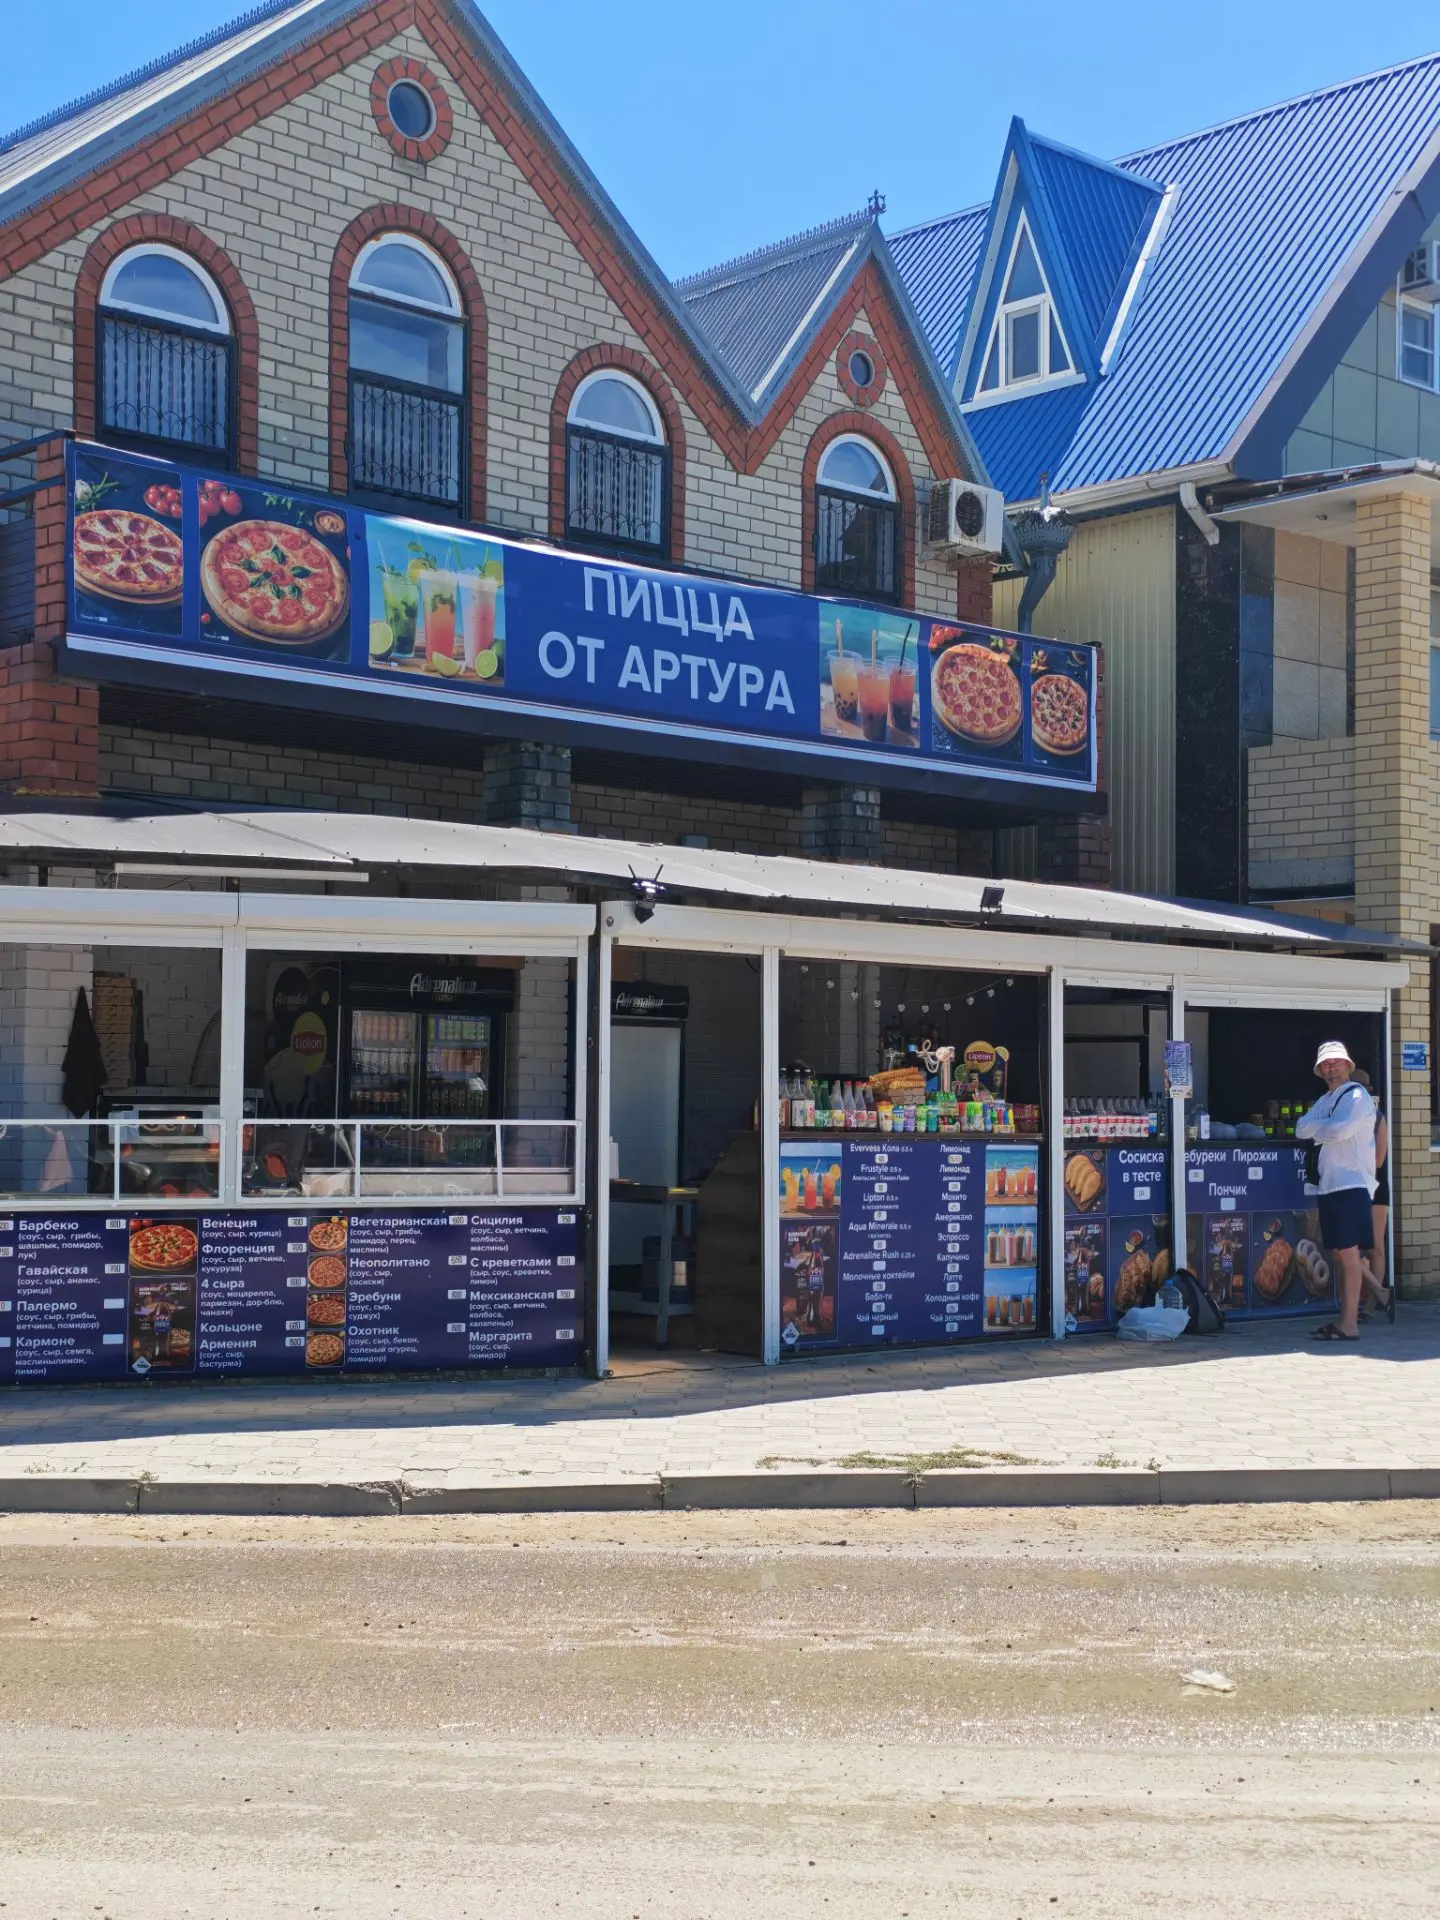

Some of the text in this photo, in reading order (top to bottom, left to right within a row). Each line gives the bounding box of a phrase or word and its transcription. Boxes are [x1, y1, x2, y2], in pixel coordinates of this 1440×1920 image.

[584, 567, 754, 642] ПИЦЦА
[539, 631, 795, 715] ОТ АРТУРА
[296, 1037, 321, 1049] Lipton
[850, 1144, 880, 1152] Evervess
[940, 1144, 970, 1153] Лимонад
[1119, 1150, 1164, 1163] Сосиска
[1184, 1149, 1226, 1165] ебуреки
[1233, 1149, 1278, 1164] Пирожки
[861, 1164, 888, 1174] Frustyle
[940, 1164, 970, 1173] Лимонад
[1123, 1172, 1161, 1182] в тесте
[1209, 1183, 1247, 1196] Пончик
[864, 1193, 884, 1203] Lipton
[942, 1192, 967, 1200] Мохито
[351, 1217, 446, 1227] Вегетарианская
[472, 1216, 523, 1226] Сицилия
[936, 1213, 972, 1221] Американо
[19, 1221, 78, 1233] Барбекю
[203, 1219, 257, 1229] Венеция
[849, 1222, 867, 1232] Aqua
[869, 1222, 898, 1230] Minerale
[938, 1233, 969, 1242] Эспрессо
[202, 1244, 275, 1255] Флоренция
[18, 1252, 36, 1260] лук)
[844, 1251, 880, 1259] Adrenaline
[937, 1253, 969, 1262] Капучино
[350, 1258, 430, 1267] Неополитано
[471, 1258, 551, 1269] С креветками
[18, 1265, 88, 1276] Гавайская
[201, 1265, 242, 1273] кукуруза)
[883, 1271, 914, 1279] коктейли
[943, 1273, 962, 1281] Латте
[201, 1279, 244, 1290] 4 сыра
[349, 1292, 401, 1303] Эребуни
[470, 1292, 554, 1300] Мексиканская
[925, 1292, 979, 1302] Холодный кофе
[17, 1301, 77, 1312] Палермо
[945, 1313, 973, 1321] зеленый
[58, 1321, 99, 1329] помидор)
[201, 1323, 262, 1333] Кольцоне
[349, 1327, 399, 1335] Охотник
[469, 1332, 532, 1342] Маргарита
[16, 1337, 74, 1348] Кармоне
[200, 1340, 256, 1350] Армения
[200, 1360, 241, 1368] бастурма)
[15, 1367, 46, 1376] лимон)
